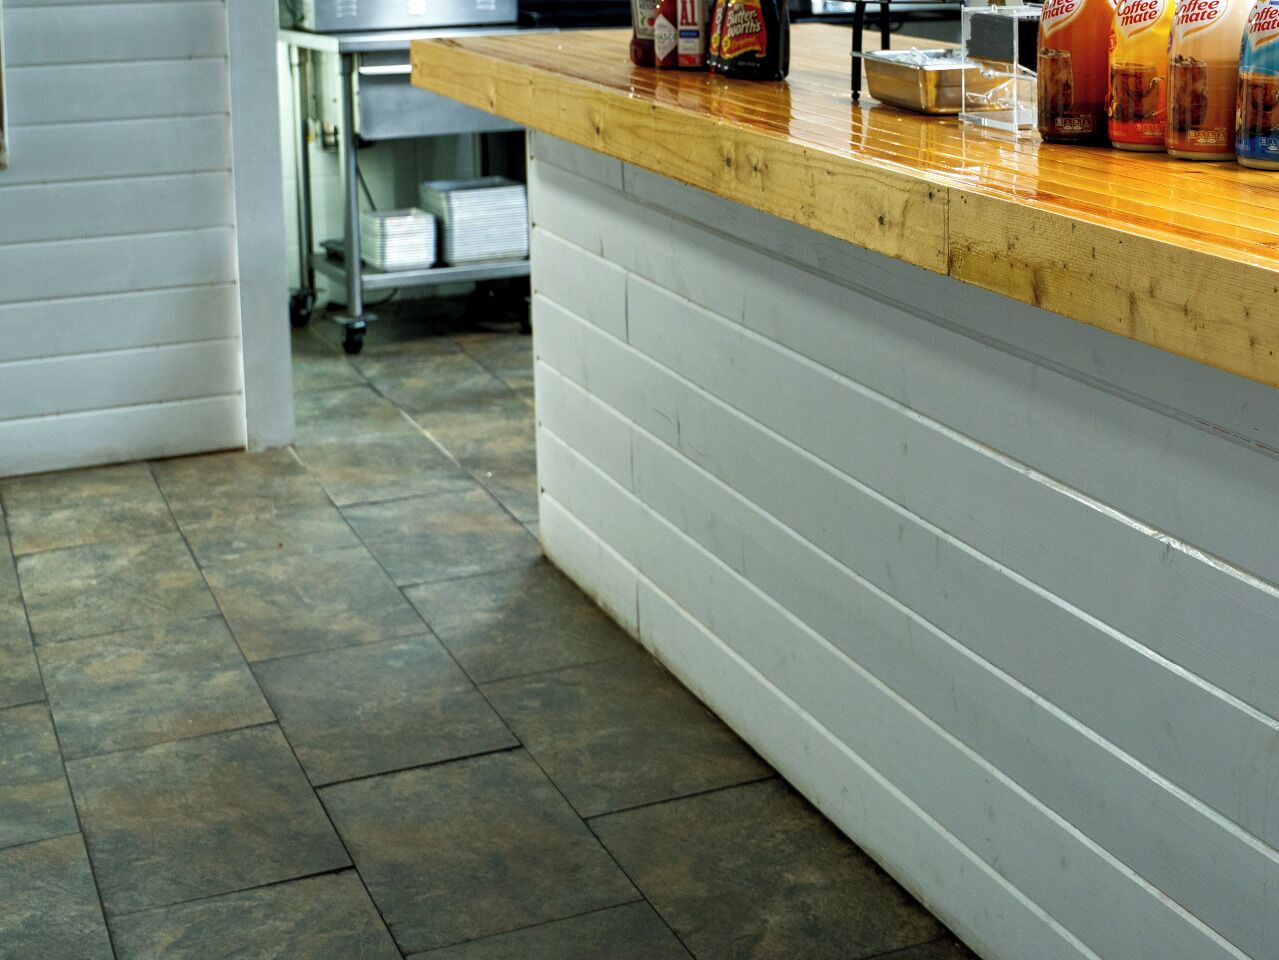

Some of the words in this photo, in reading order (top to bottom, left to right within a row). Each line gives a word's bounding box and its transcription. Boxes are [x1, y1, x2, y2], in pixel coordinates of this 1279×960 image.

[1117, 0, 1158, 16] Coffee
[1120, 10, 1158, 26] mate
[1176, 10, 1218, 26] mate
